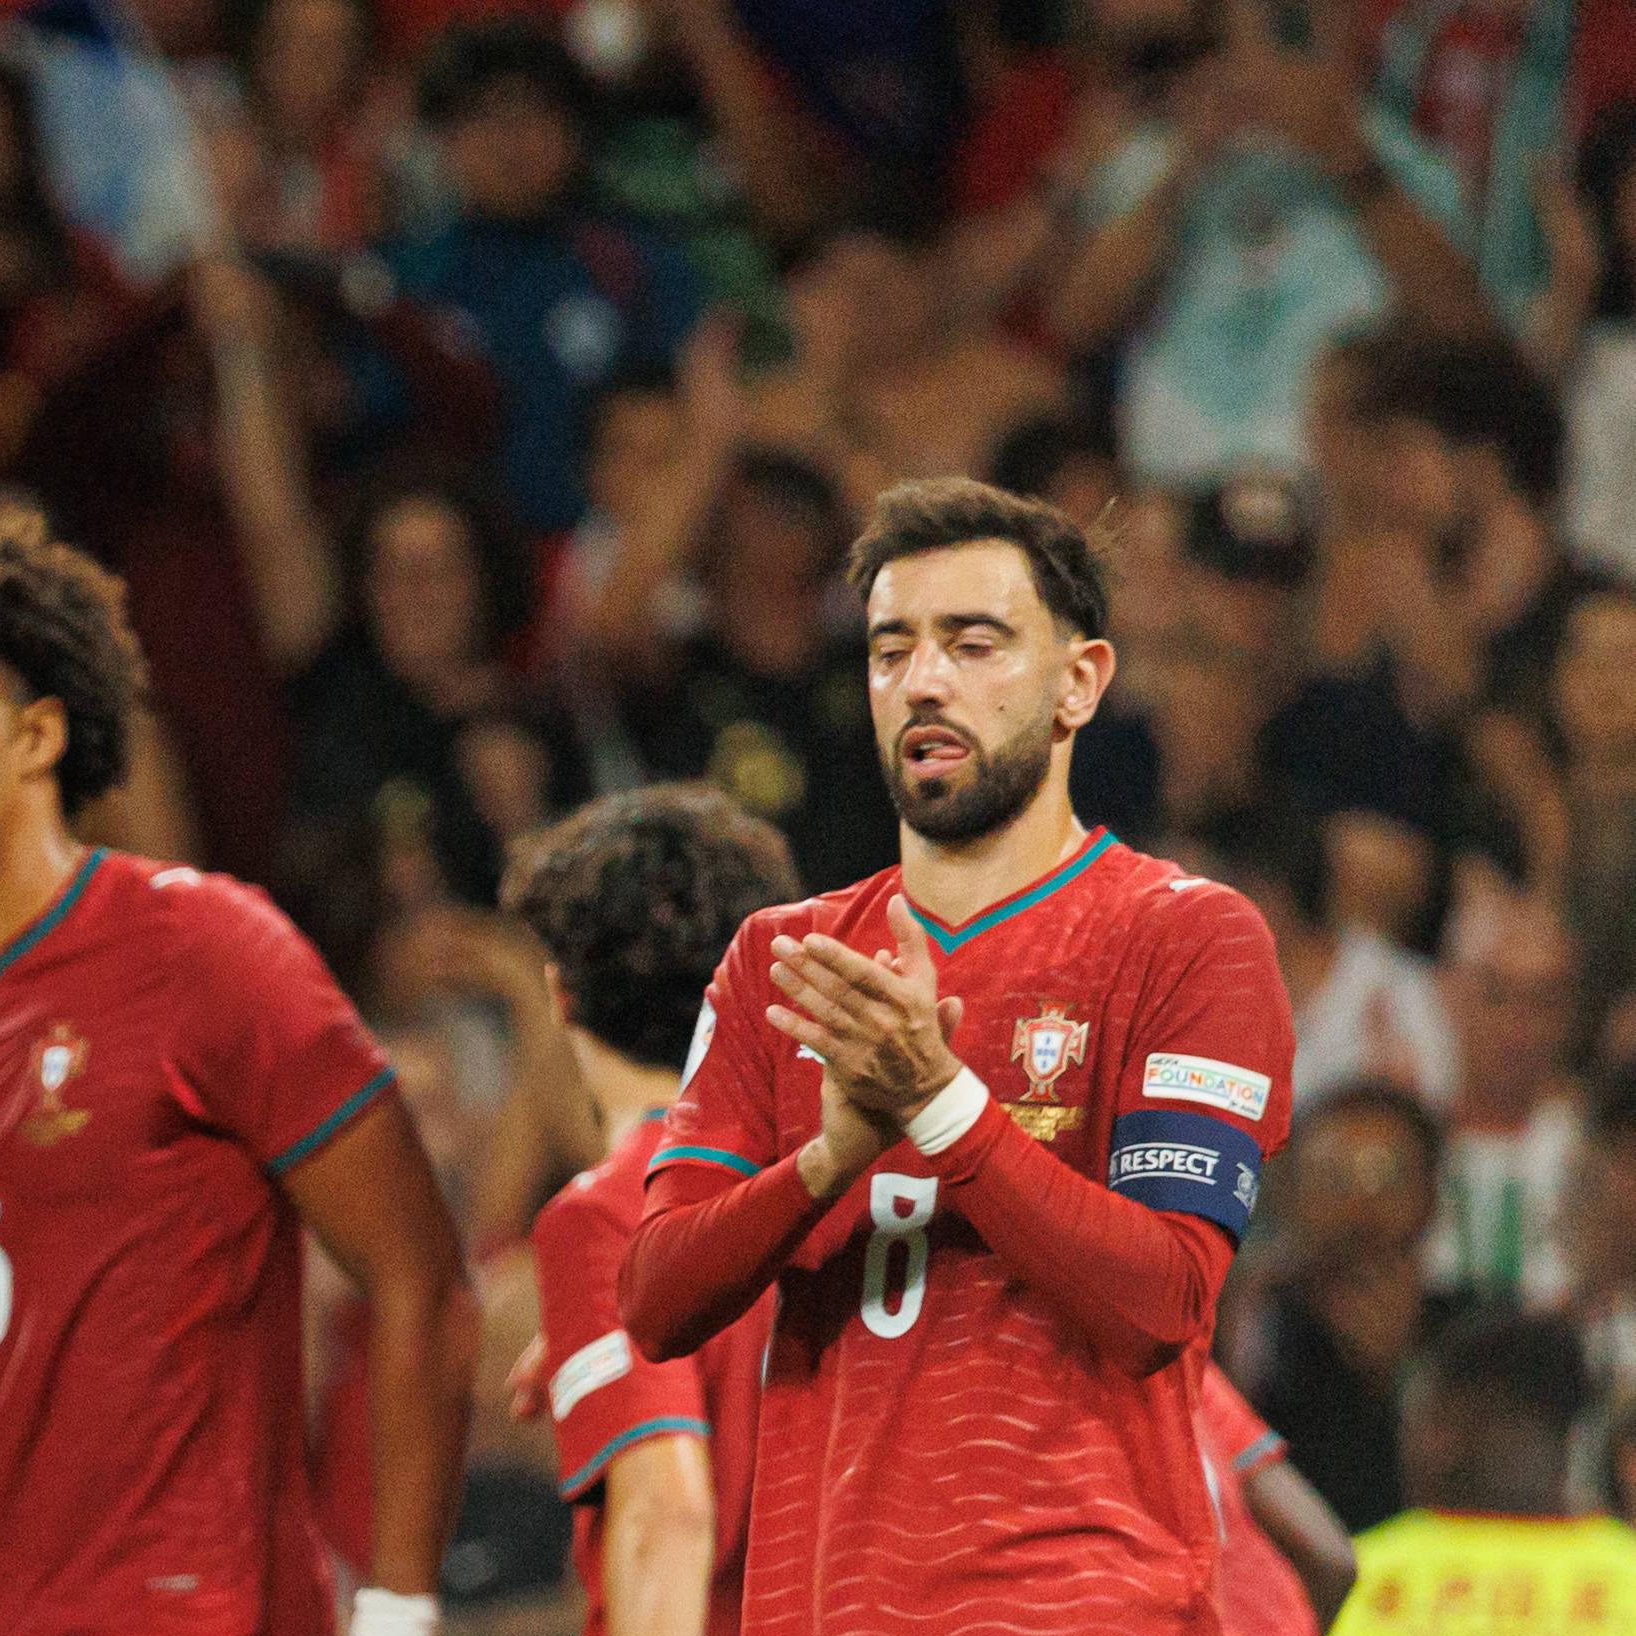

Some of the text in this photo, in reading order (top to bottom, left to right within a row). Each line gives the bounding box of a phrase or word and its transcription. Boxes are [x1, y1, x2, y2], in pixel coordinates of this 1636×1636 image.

[1147, 1066, 1265, 1107] FOUNDATION
[1120, 1149, 1220, 1177] RESPECT
[861, 1173, 938, 1340] 8
